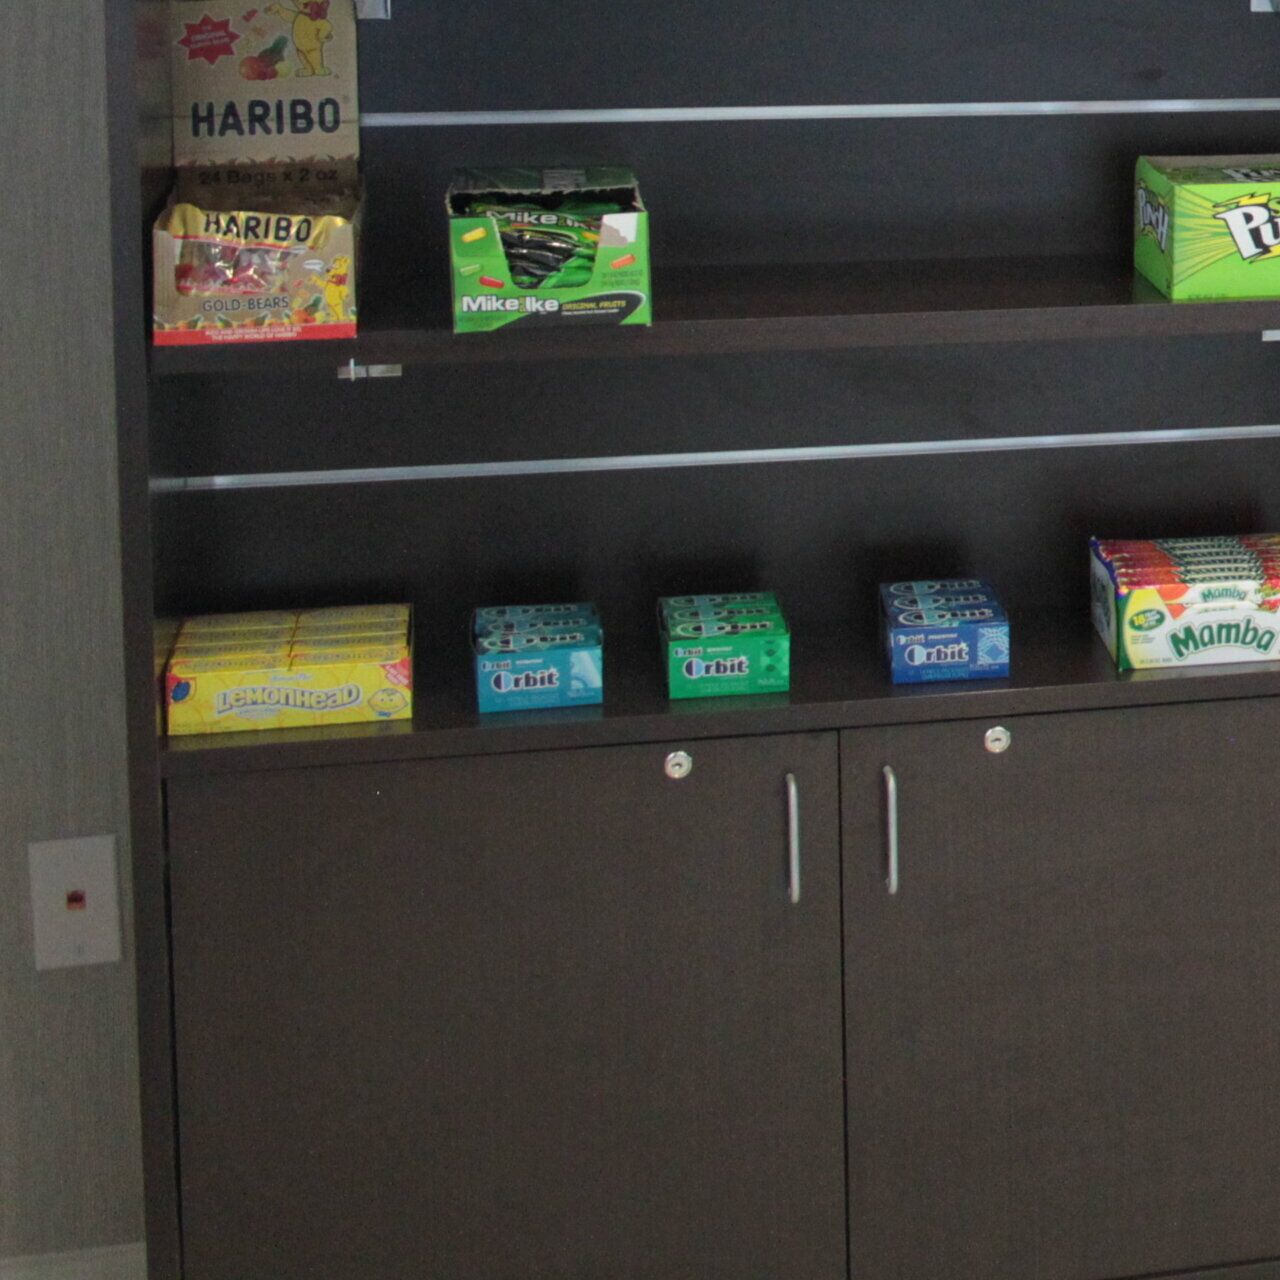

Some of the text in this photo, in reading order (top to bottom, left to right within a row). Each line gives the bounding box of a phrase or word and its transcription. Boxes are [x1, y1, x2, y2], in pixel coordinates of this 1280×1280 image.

[192, 96, 341, 138] HARIBO
[226, 170, 276, 187] Bags
[203, 213, 312, 242] HARIBO
[203, 295, 290, 312] GOLD-BEARS
[461, 296, 559, 312] Mike Ike
[1202, 585, 1247, 603] Mamba
[1169, 616, 1276, 658] Mamba
[905, 641, 969, 666] Orbit
[683, 656, 749, 679] Orbit
[491, 667, 559, 693] Orbit
